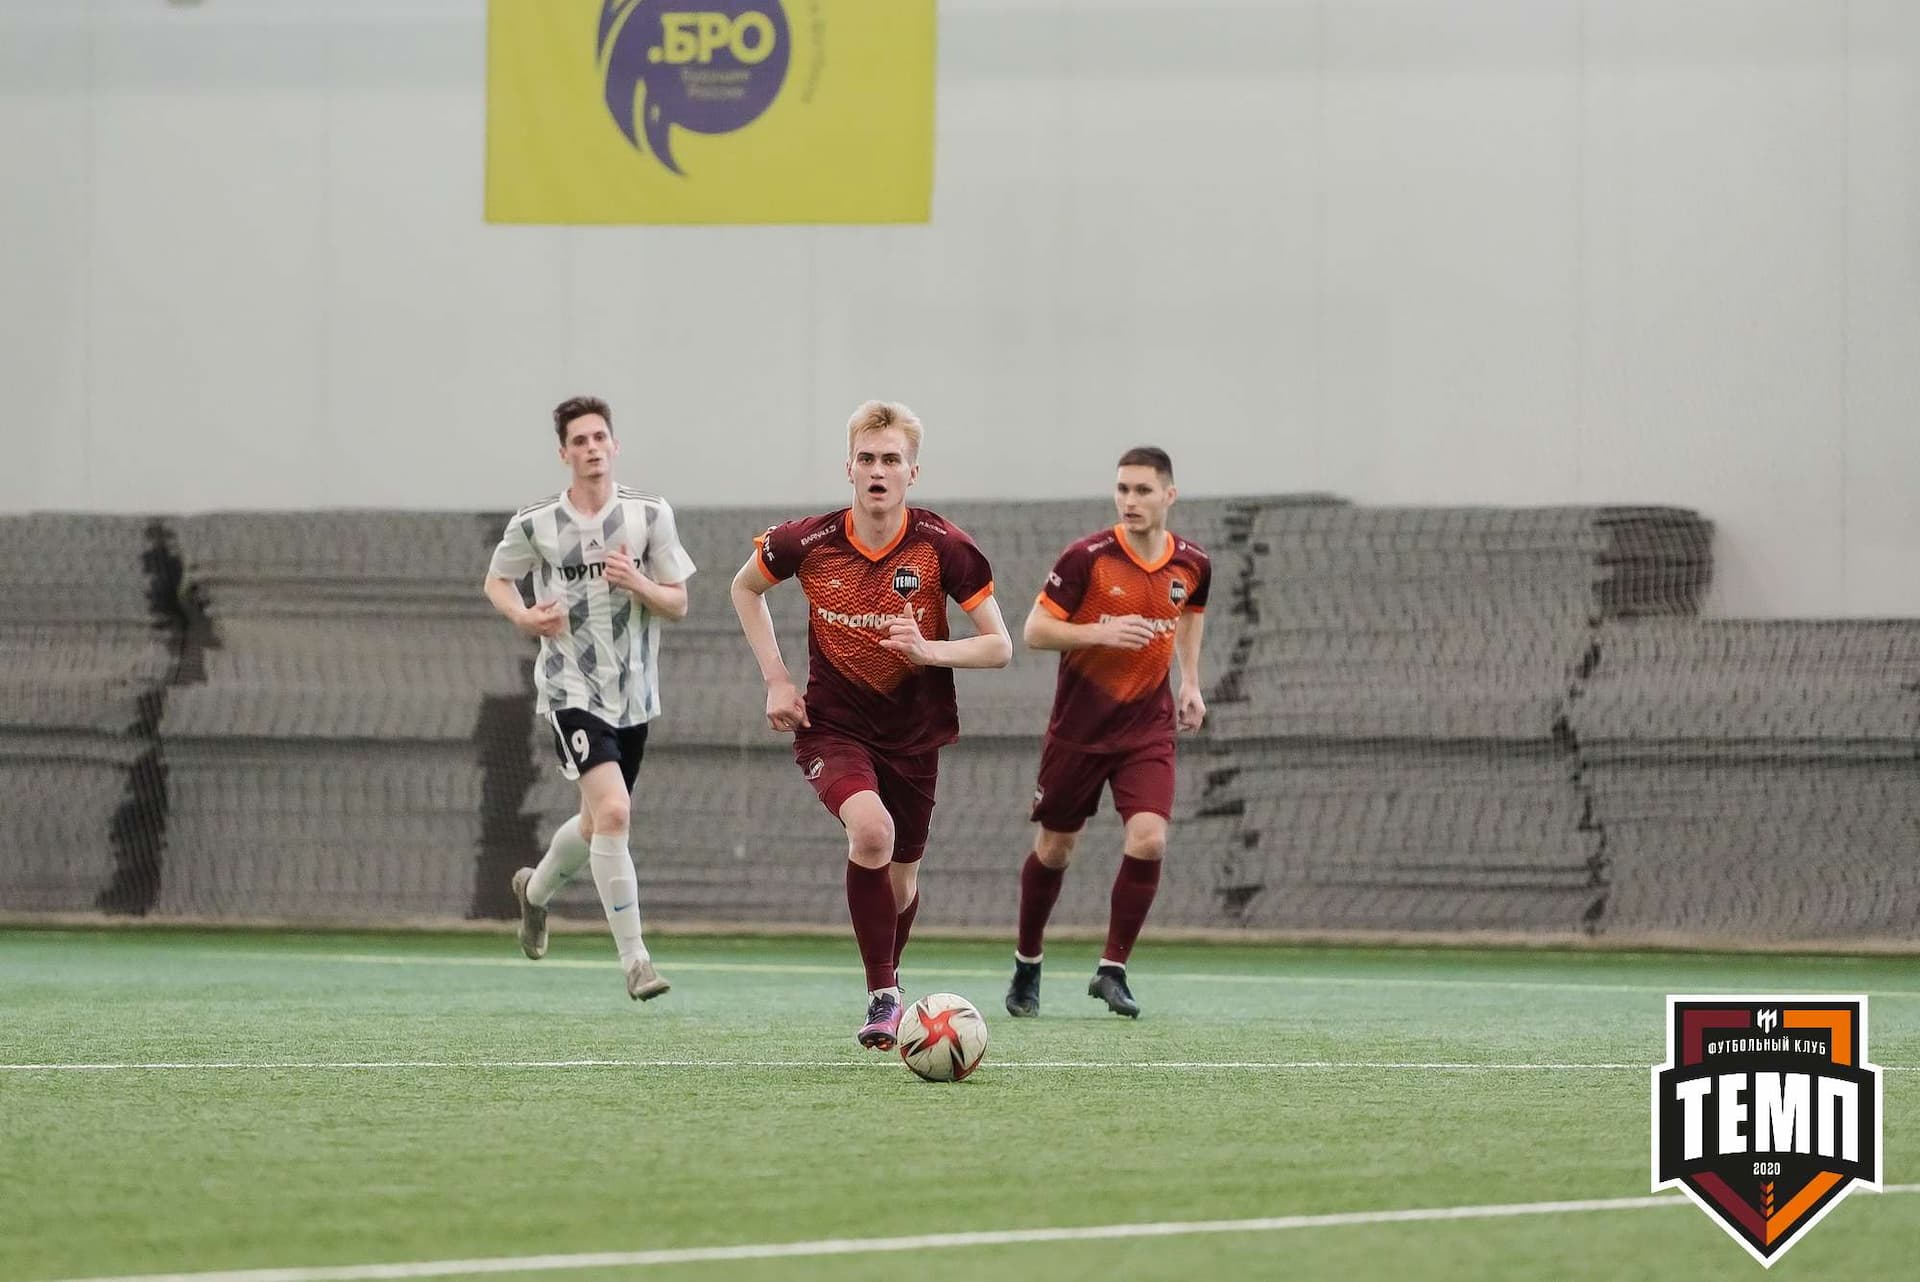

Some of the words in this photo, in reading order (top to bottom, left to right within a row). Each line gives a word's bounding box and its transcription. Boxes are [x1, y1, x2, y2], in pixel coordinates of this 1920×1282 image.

[648, 11, 776, 64] .БРО
[896, 576, 918, 588] ТЕМП
[571, 728, 590, 763] 9
